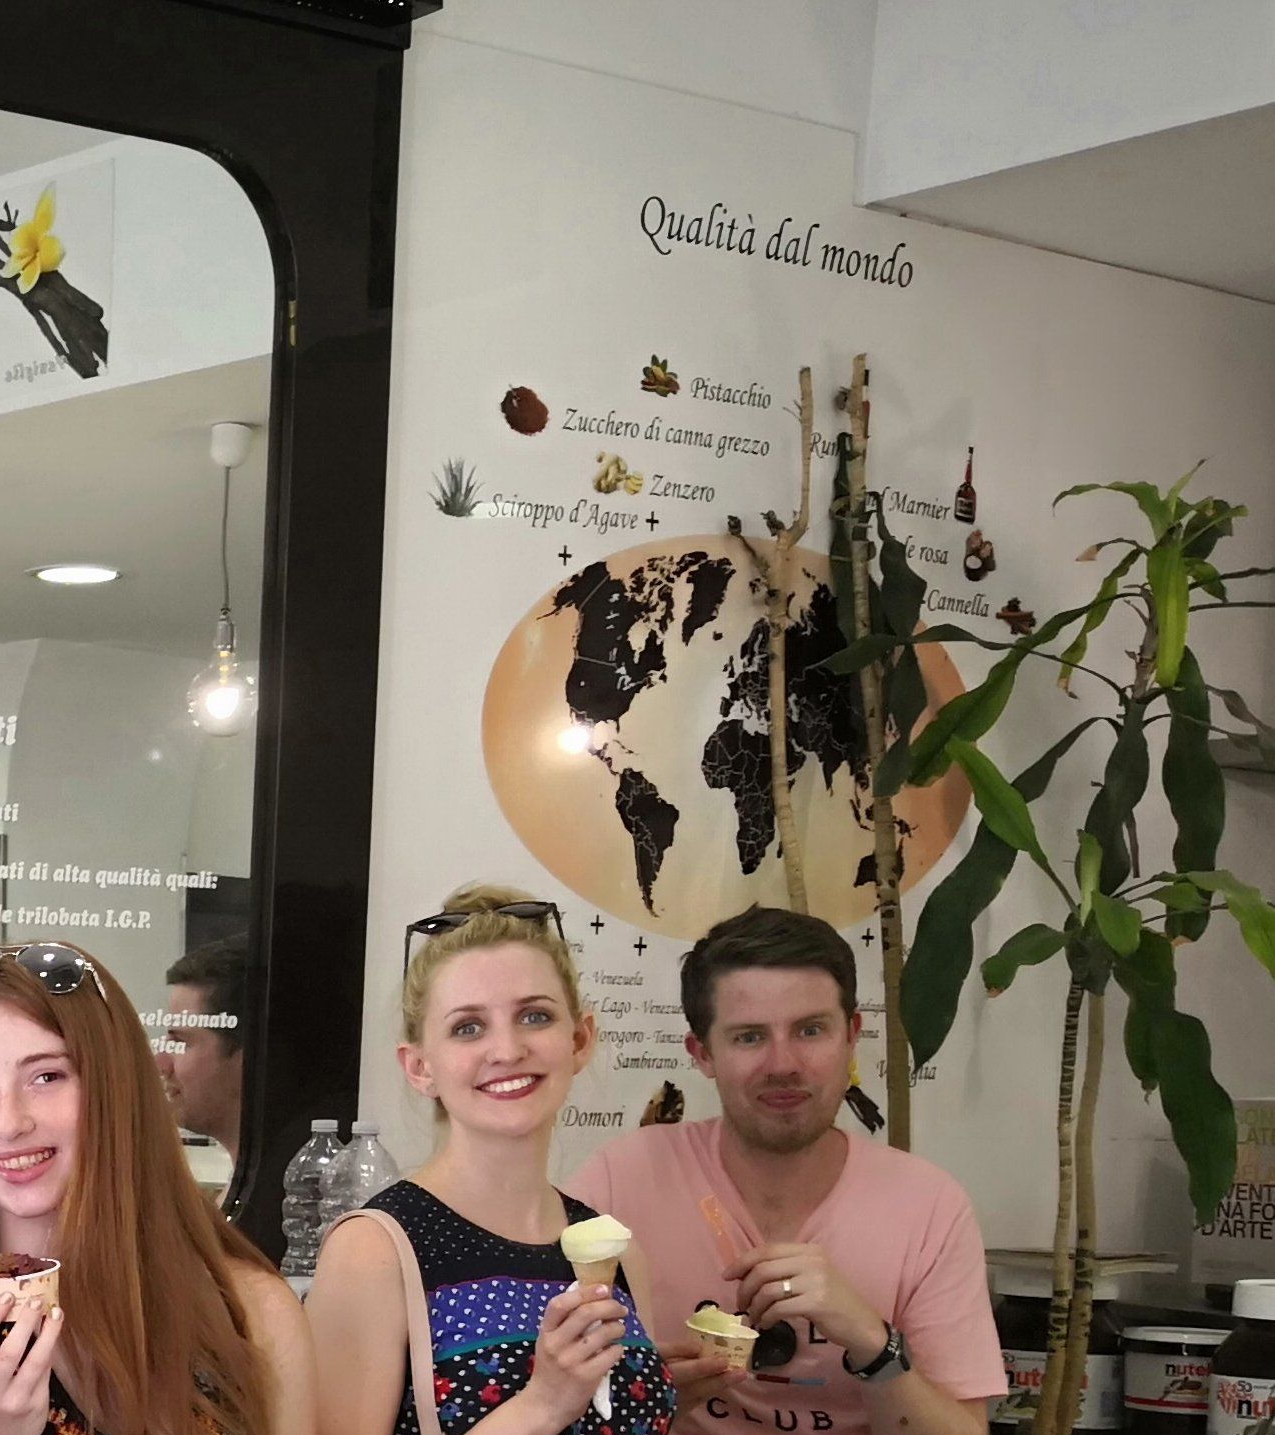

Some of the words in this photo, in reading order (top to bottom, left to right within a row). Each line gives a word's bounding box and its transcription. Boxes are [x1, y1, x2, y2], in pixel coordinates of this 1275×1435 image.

[640, 196, 756, 256] Qualità
[765, 217, 820, 267] dal
[820, 243, 913, 288] mondo
[690, 376, 772, 410] Pistacchio
[562, 407, 640, 440] Zucchero
[644, 416, 661, 442] di
[665, 425, 713, 450] canna
[717, 432, 771, 459] grezzo
[649, 474, 716, 503] Zenzero
[488, 494, 565, 530] Sciroppo
[569, 499, 639, 535] d'Agave
[889, 491, 950, 521] Marnier
[919, 548, 949, 566] rosa
[926, 588, 990, 618] Cannella
[29, 862, 48, 882] di
[53, 864, 91, 883] alta
[95, 867, 161, 889] qualità
[165, 870, 219, 892] quali:
[17, 906, 100, 928] trilobata
[104, 908, 152, 929] I.G.P.
[592, 970, 644, 987] Venezuela
[599, 997, 632, 1019] Lago
[598, 1028, 645, 1049] orogoro
[613, 1050, 679, 1071] Sambirano
[562, 1104, 626, 1128] Domori
